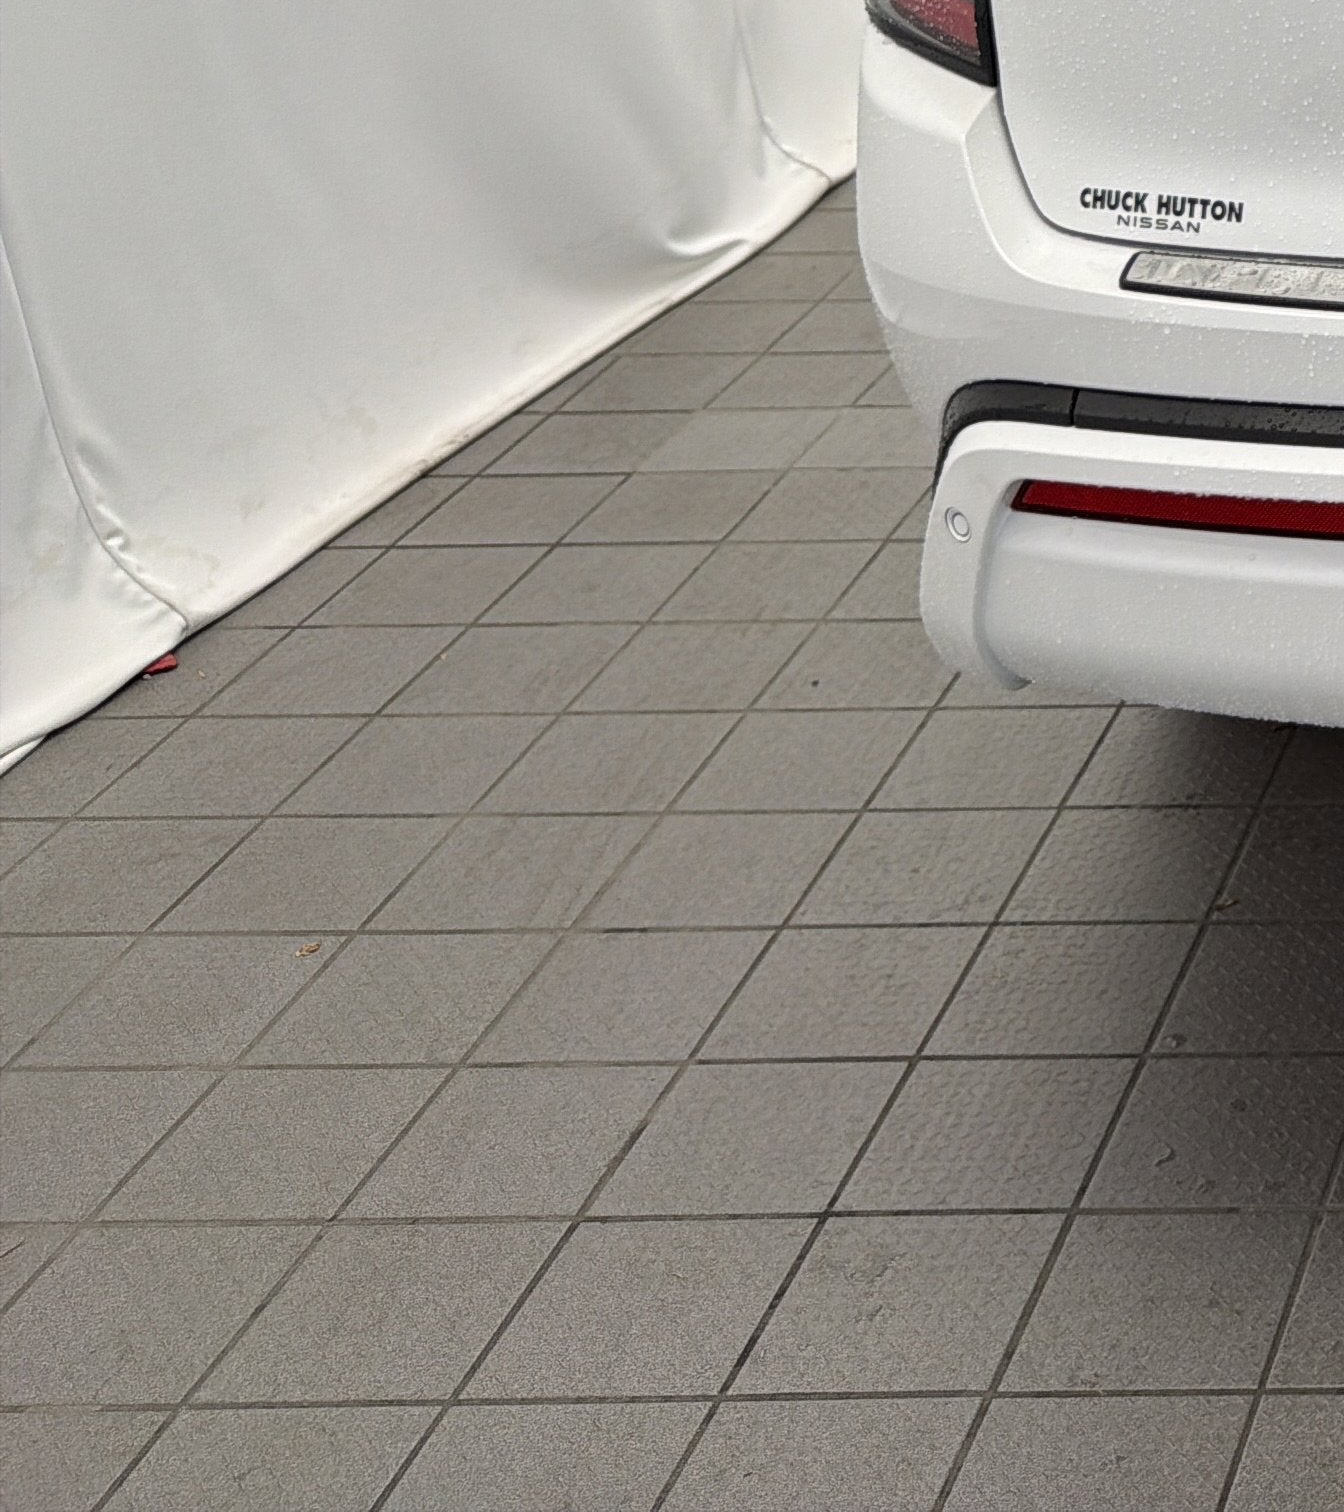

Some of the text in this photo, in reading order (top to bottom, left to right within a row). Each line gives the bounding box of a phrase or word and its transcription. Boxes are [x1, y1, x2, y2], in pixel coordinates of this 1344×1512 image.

[1080, 187, 1244, 222] CHUCK HUTTON
[1116, 215, 1201, 234] NISSAN
